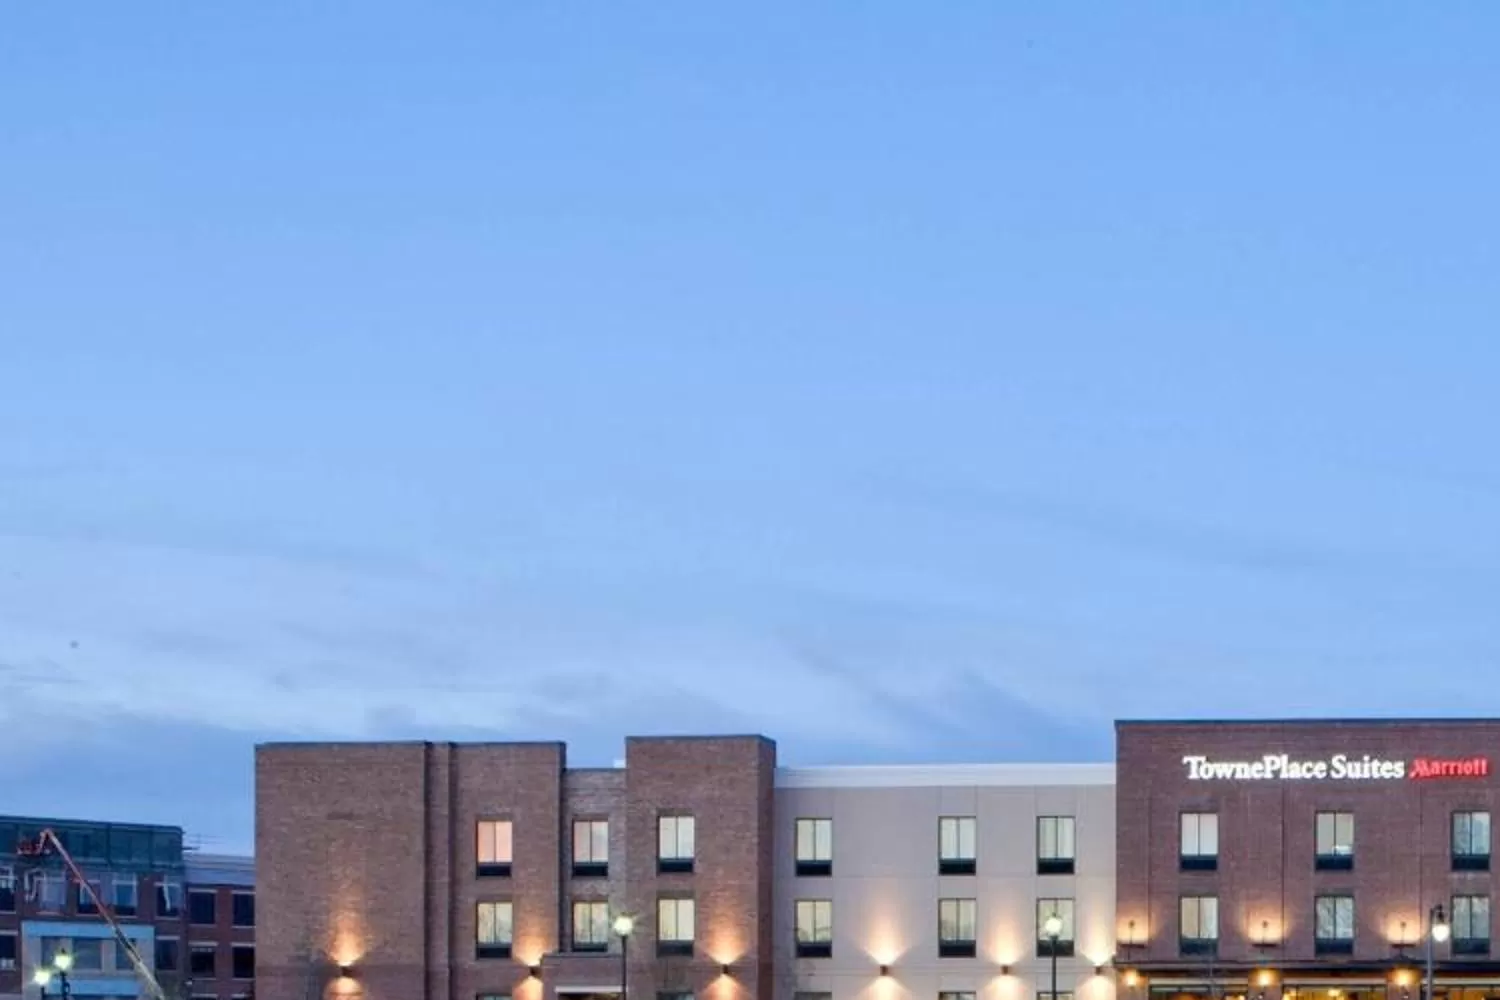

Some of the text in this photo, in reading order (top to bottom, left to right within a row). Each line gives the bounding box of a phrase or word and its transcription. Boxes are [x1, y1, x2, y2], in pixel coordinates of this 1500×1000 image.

[1182, 754, 1488, 780] TownePlace Suites Marriott
